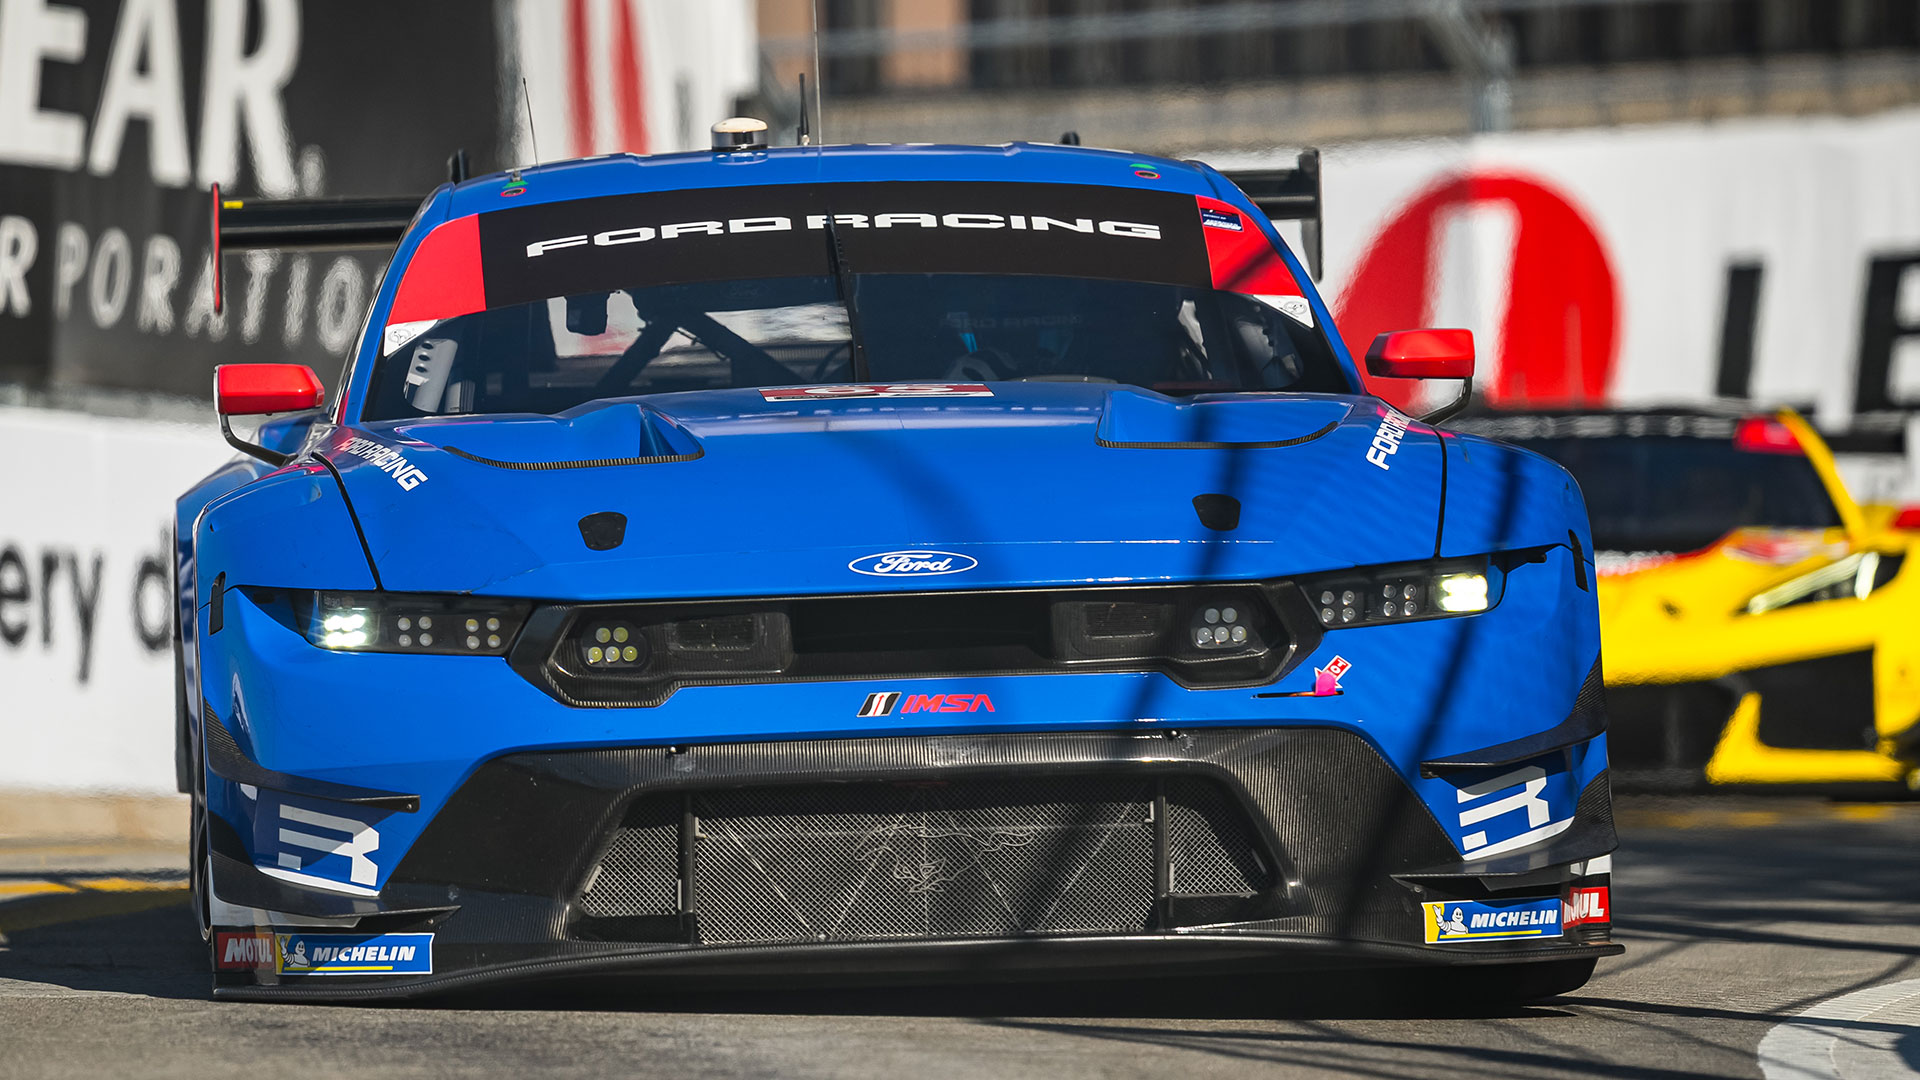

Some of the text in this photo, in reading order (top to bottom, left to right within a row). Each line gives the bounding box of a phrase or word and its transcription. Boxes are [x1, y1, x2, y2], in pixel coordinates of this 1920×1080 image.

[527, 213, 1162, 257] FORD RACING
[1366, 422, 1405, 471] FORD
[363, 443, 429, 492] RACING
[874, 554, 953, 573] Ford
[900, 694, 996, 714] IMSA
[1470, 910, 1558, 928] MICHELIN
[224, 938, 416, 963] MOTUL MICHELIN
